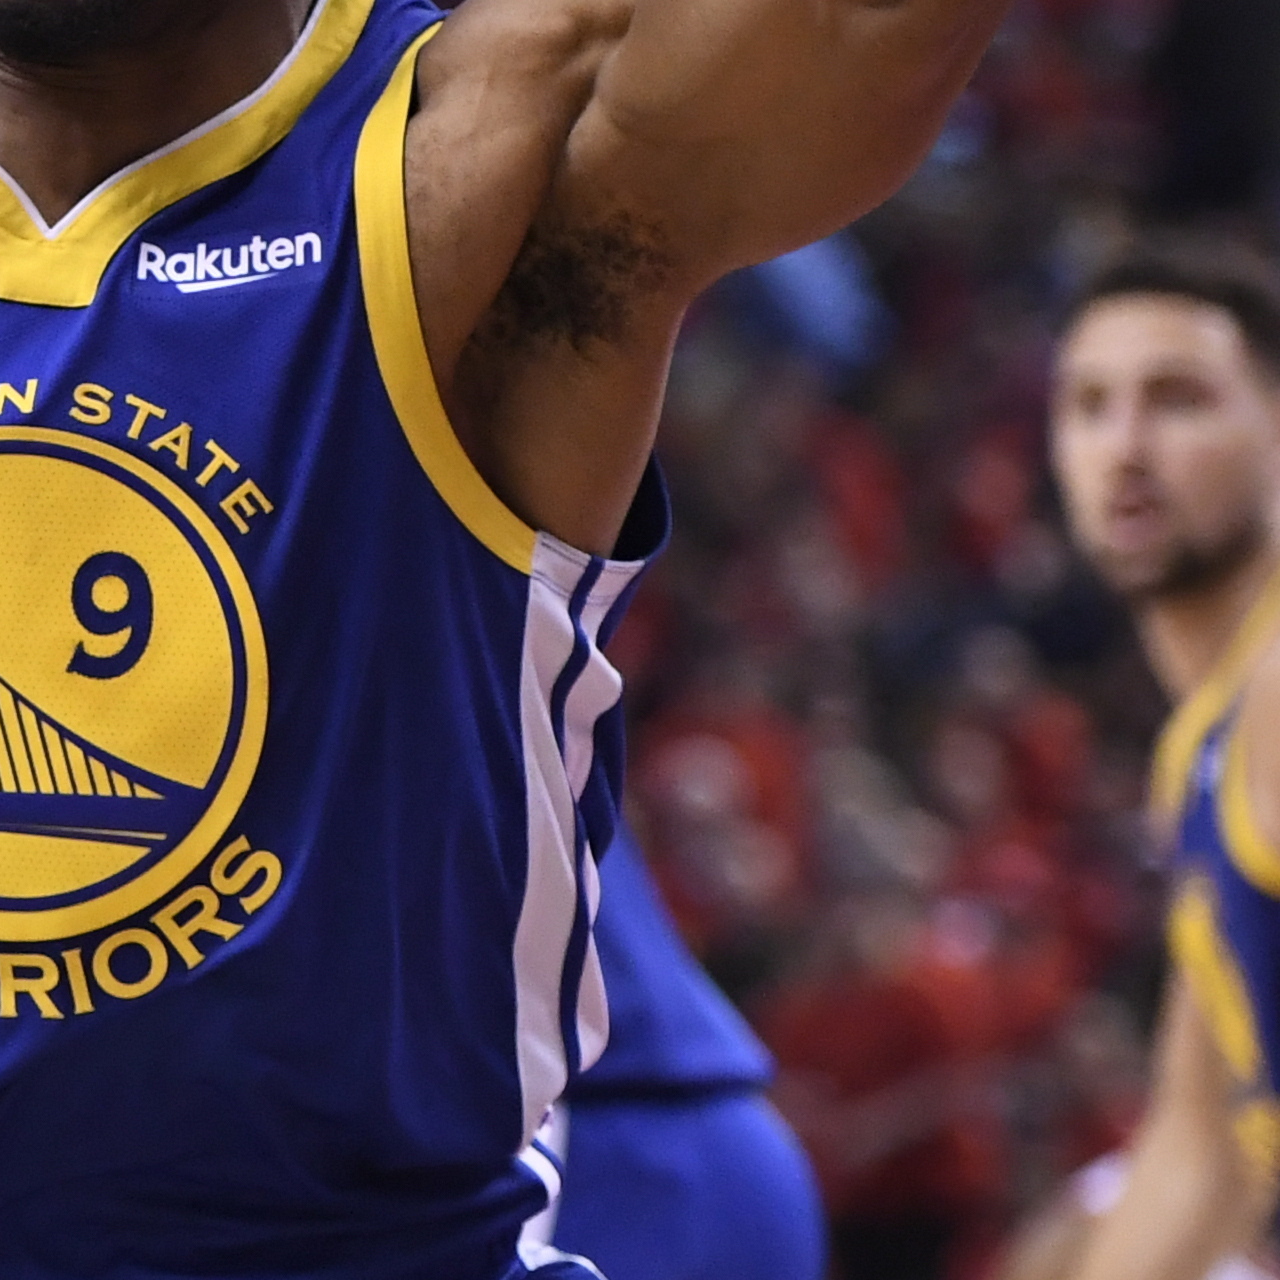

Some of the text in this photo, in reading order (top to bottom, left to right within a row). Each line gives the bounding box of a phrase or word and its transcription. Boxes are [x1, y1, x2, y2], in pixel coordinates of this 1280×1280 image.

[136, 231, 322, 283] Rakuten
[68, 382, 275, 535] STATE
[66, 550, 154, 680] 9
